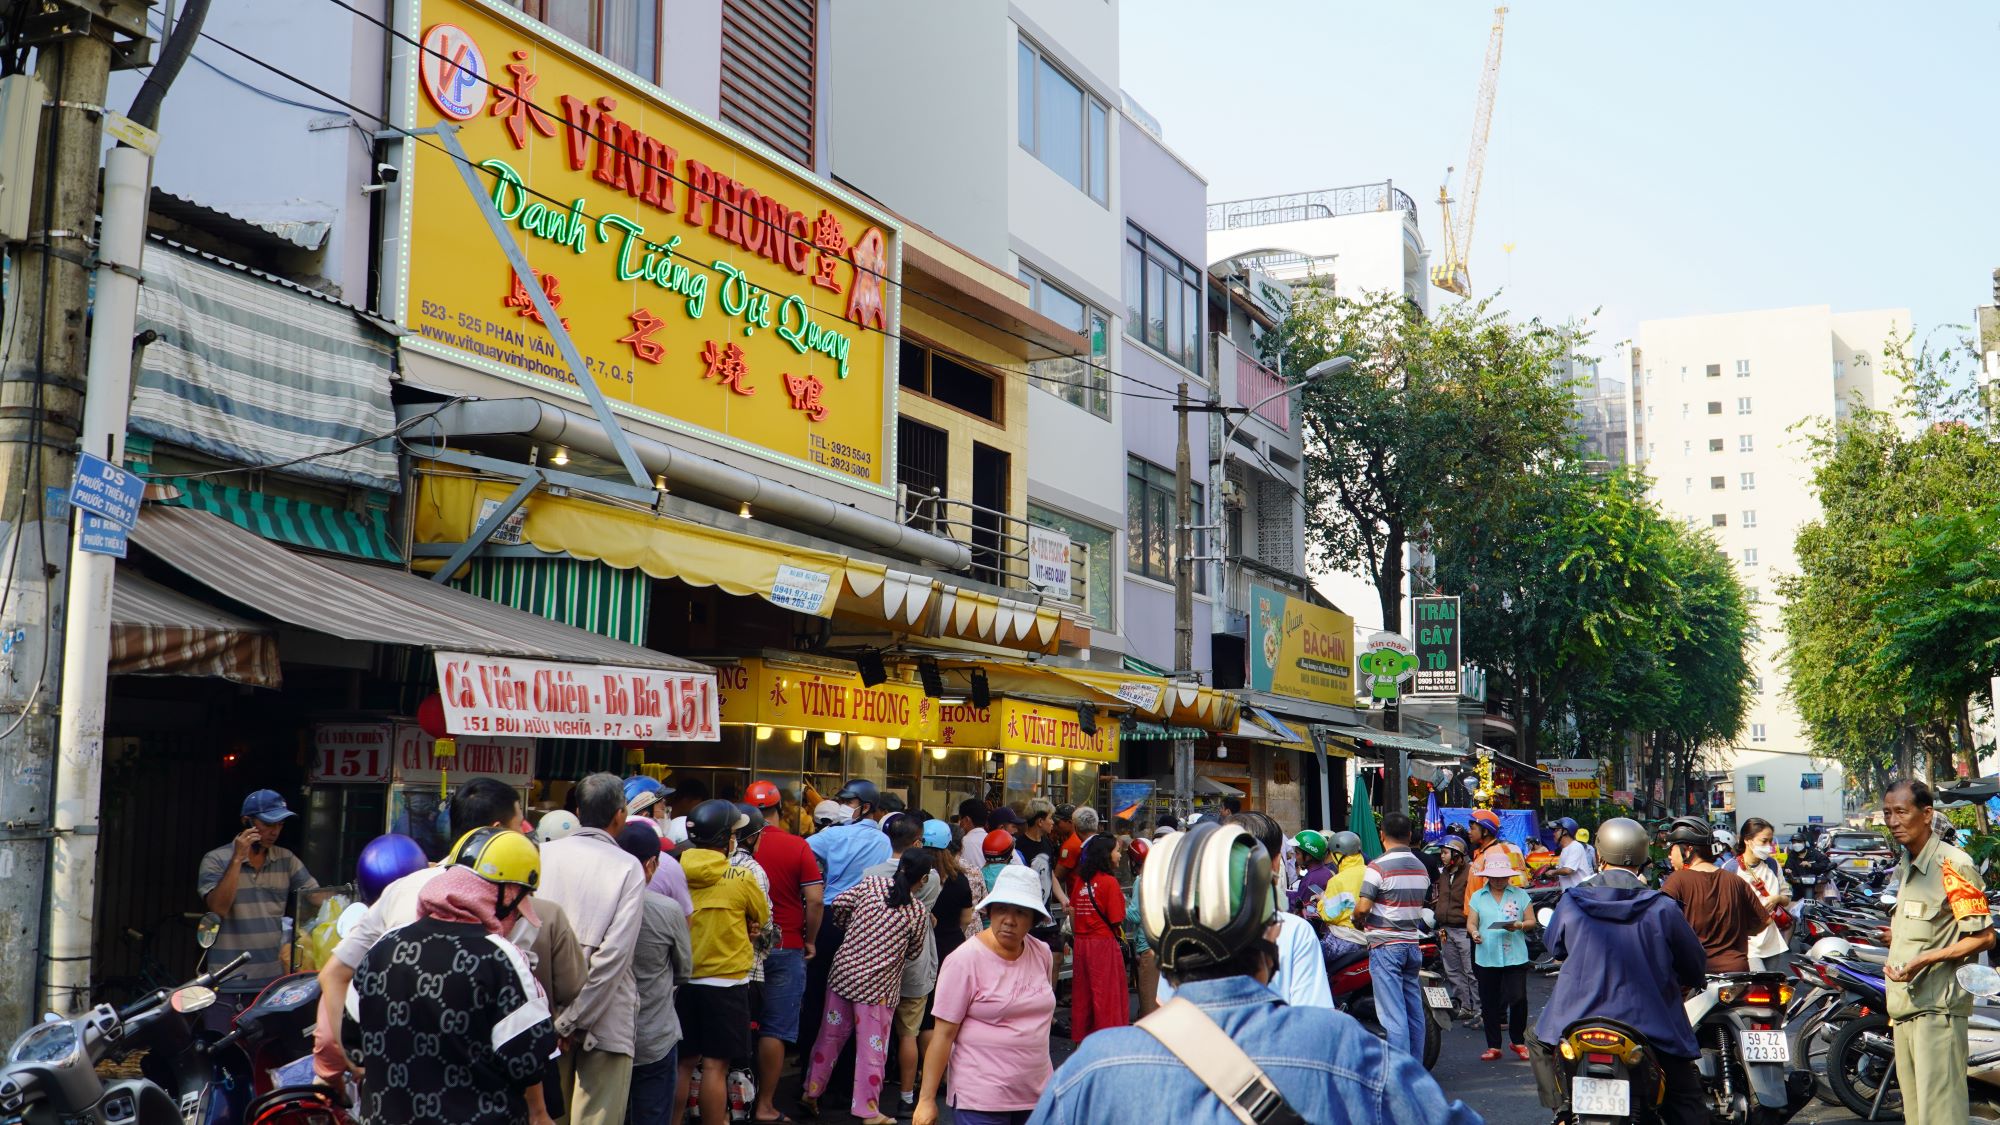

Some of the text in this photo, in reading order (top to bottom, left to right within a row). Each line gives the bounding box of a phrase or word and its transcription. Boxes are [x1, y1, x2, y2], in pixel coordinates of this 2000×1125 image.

[490, 50, 557, 150] 永
[684, 159, 811, 275] PHONG
[479, 159, 850, 378] Danh Tiếng Vịt Quay
[421, 300, 446, 321] 523
[458, 312, 482, 333] 525
[486, 322, 524, 348] PHAN
[528, 336, 554, 358] VĂN
[1419, 600, 1455, 620] TRÁI
[1421, 625, 1452, 645] CÂY
[1427, 650, 1447, 669] TÔ
[445, 661, 477, 708] Cá
[478, 665, 529, 710] Viên
[533, 670, 591, 714] Chiên
[603, 674, 629, 716] Bò
[632, 676, 662, 718] Bía
[664, 676, 716, 739] 151
[770, 676, 788, 707] 永
[852, 688, 910, 725] PHONG
[463, 717, 489, 731] 151
[496, 714, 520, 732] BÙI
[524, 716, 550, 734] HỮU
[554, 718, 592, 736] NGHĨA
[604, 723, 622, 736] P.7
[634, 724, 653, 739] Q.5
[321, 749, 381, 776] 151
[403, 731, 421, 770] CÁ
[463, 737, 505, 773] CHIÊN
[509, 746, 529, 774] 151
[1305, 842, 1318, 853] Grab
[1746, 1047, 1785, 1060] 223.38
[1576, 1096, 1625, 1112] 225.98
